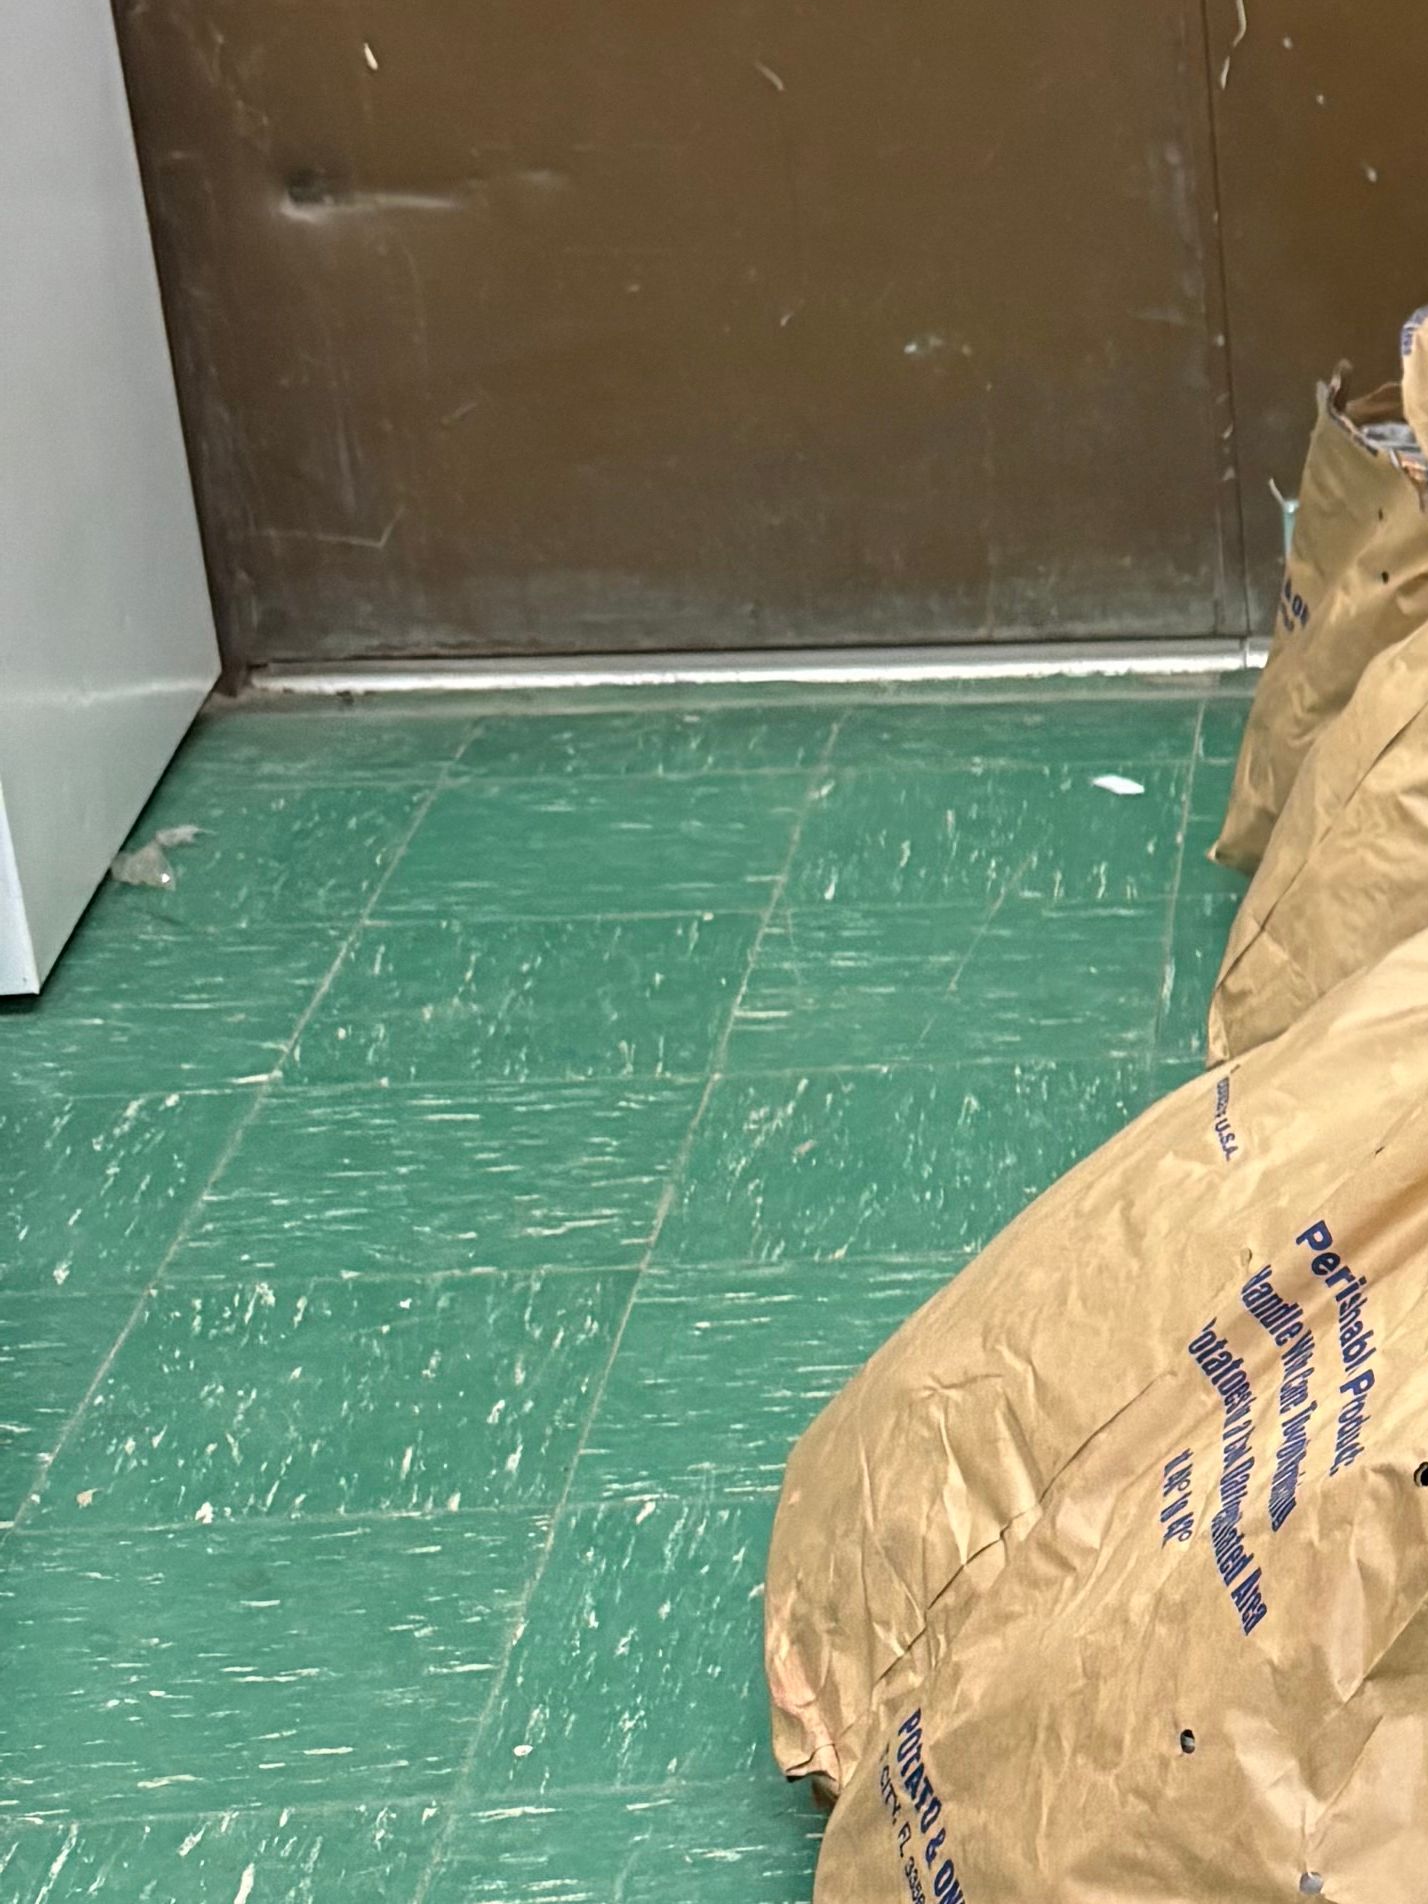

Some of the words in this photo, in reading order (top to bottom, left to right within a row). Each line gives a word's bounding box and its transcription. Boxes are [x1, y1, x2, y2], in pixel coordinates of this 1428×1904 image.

[1230, 1566, 1268, 1637] Area
[896, 1707, 942, 1834] POTATO
[925, 1827, 947, 1870] &
